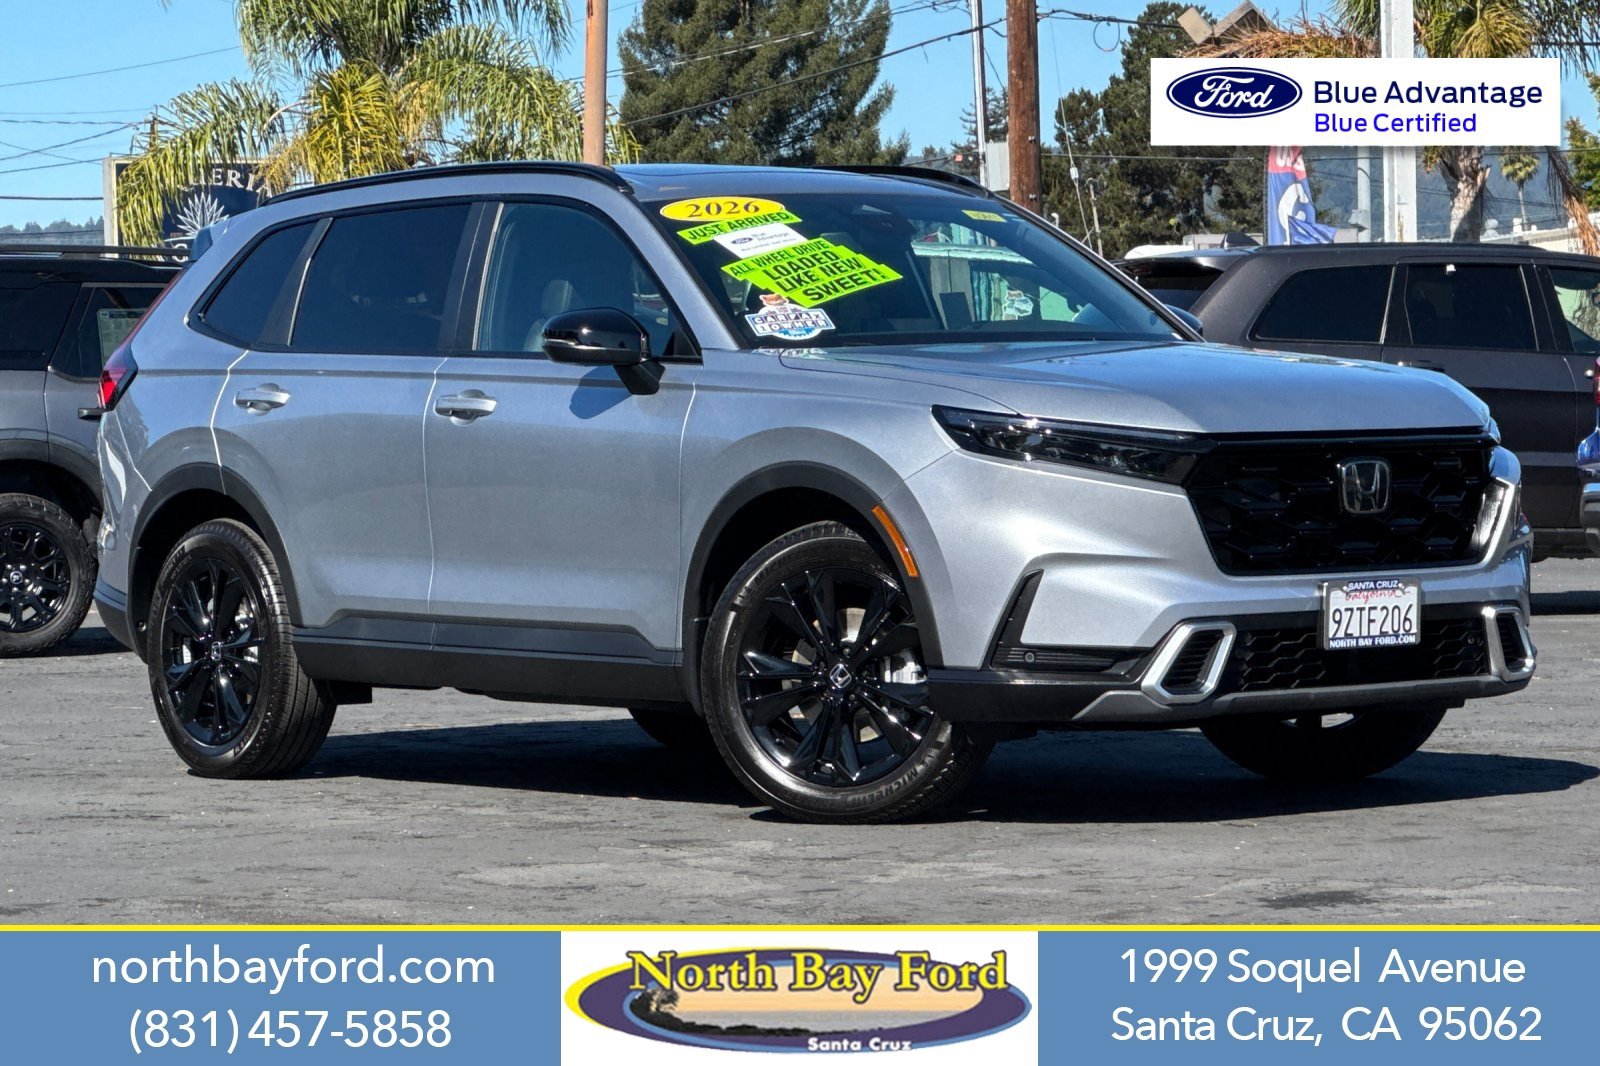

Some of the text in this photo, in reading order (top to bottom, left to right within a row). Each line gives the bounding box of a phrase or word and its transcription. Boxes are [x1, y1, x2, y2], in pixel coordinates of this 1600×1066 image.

[685, 200, 760, 218] 2026
[688, 211, 790, 240] JUST ARRIVED
[730, 261, 754, 277] ALL
[755, 250, 796, 269] WHEEL
[798, 240, 834, 259] DRIVE
[761, 250, 840, 280] LOADED
[774, 257, 863, 293] LIKE NEW
[802, 267, 886, 302] SWEET!
[1348, 580, 1398, 590] SANTA CRUZ
[1332, 603, 1413, 638] 9ZTF206
[1329, 635, 1416, 648] NORTH BAY FORD.COM
